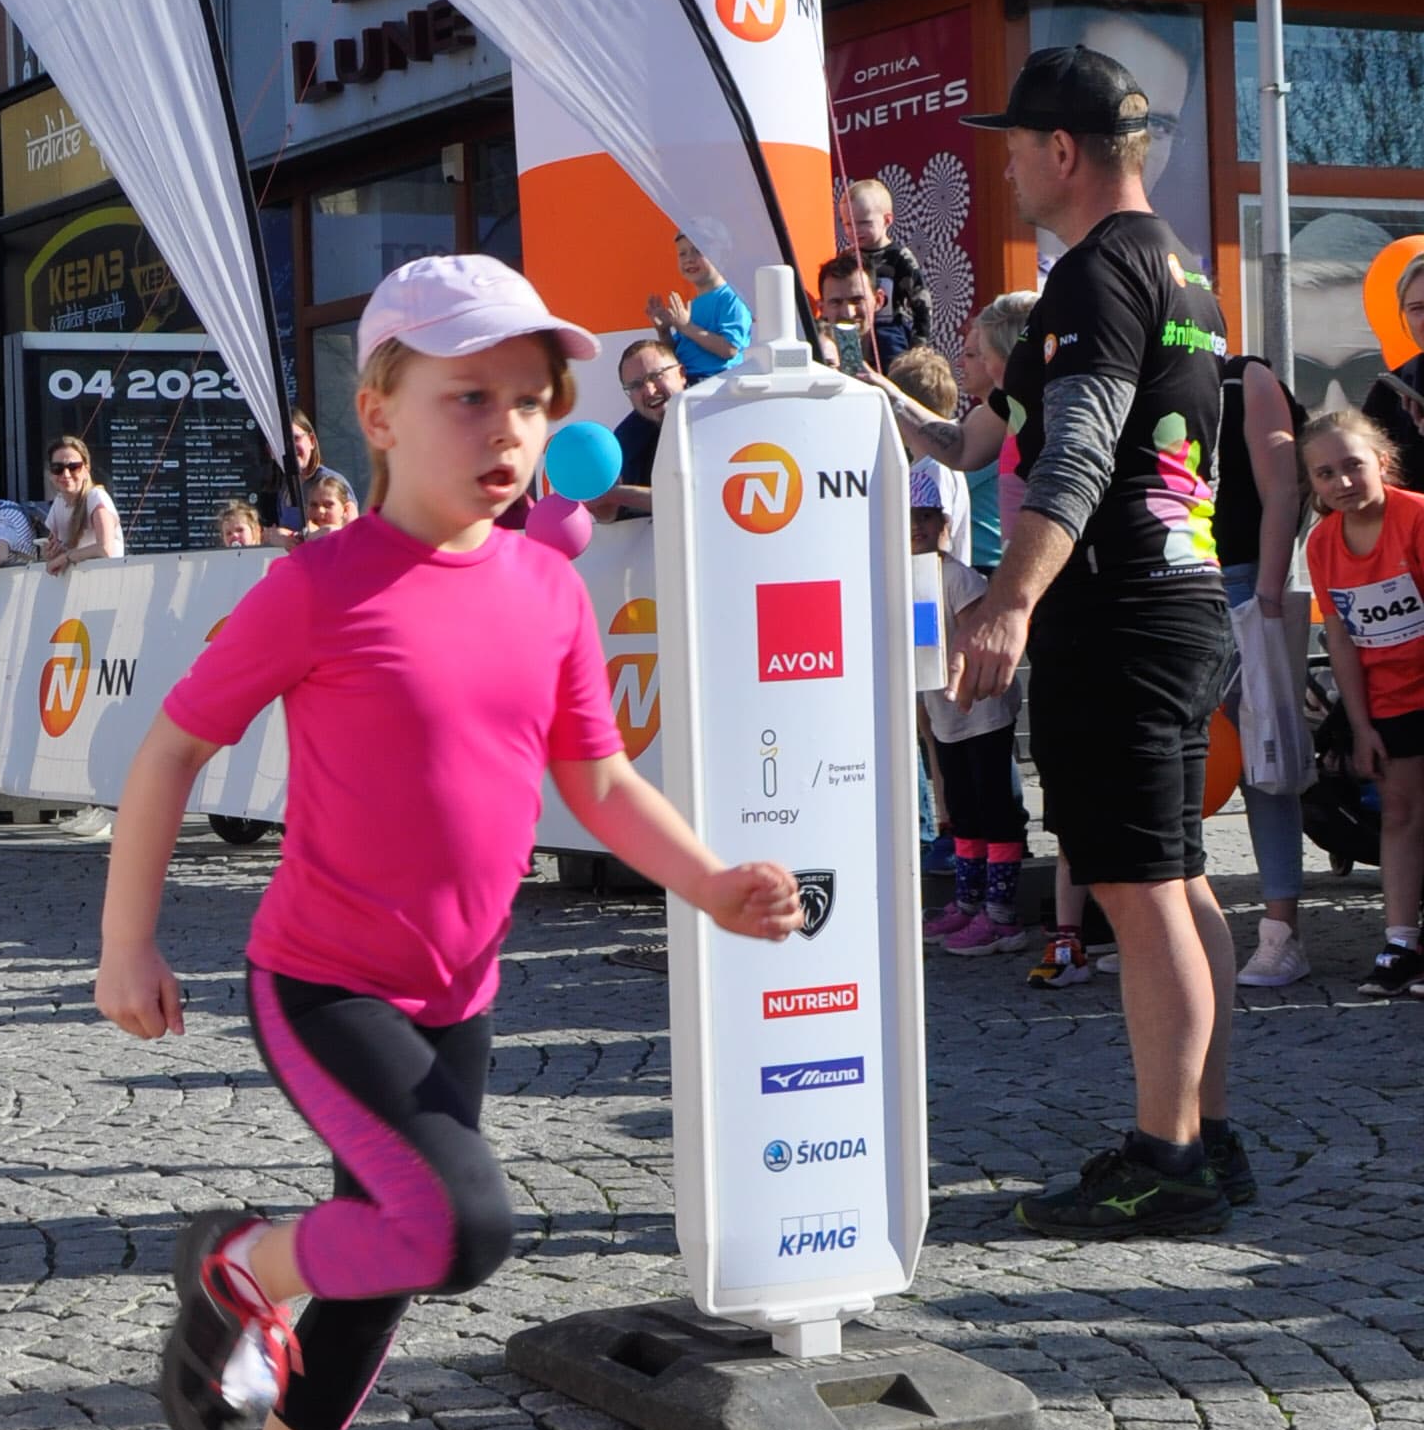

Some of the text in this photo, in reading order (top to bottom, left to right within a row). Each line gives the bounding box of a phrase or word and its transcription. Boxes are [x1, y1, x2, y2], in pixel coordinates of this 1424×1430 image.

[854, 56, 920, 84] OPTIKA
[834, 78, 969, 135] UNETTES
[1059, 333, 1079, 347] NN
[48, 369, 115, 400] 04
[127, 369, 247, 400] 2023
[817, 470, 869, 500] NN
[1358, 596, 1421, 624] 3042
[767, 650, 835, 673] AVON
[96, 659, 137, 696] NN
[828, 761, 866, 773] Powered
[828, 772, 866, 787] by MVM
[741, 808, 800, 825] innogy
[768, 988, 855, 1014] NUTREND
[796, 1137, 868, 1165] ŠKODA
[778, 1226, 857, 1258] KPMG
